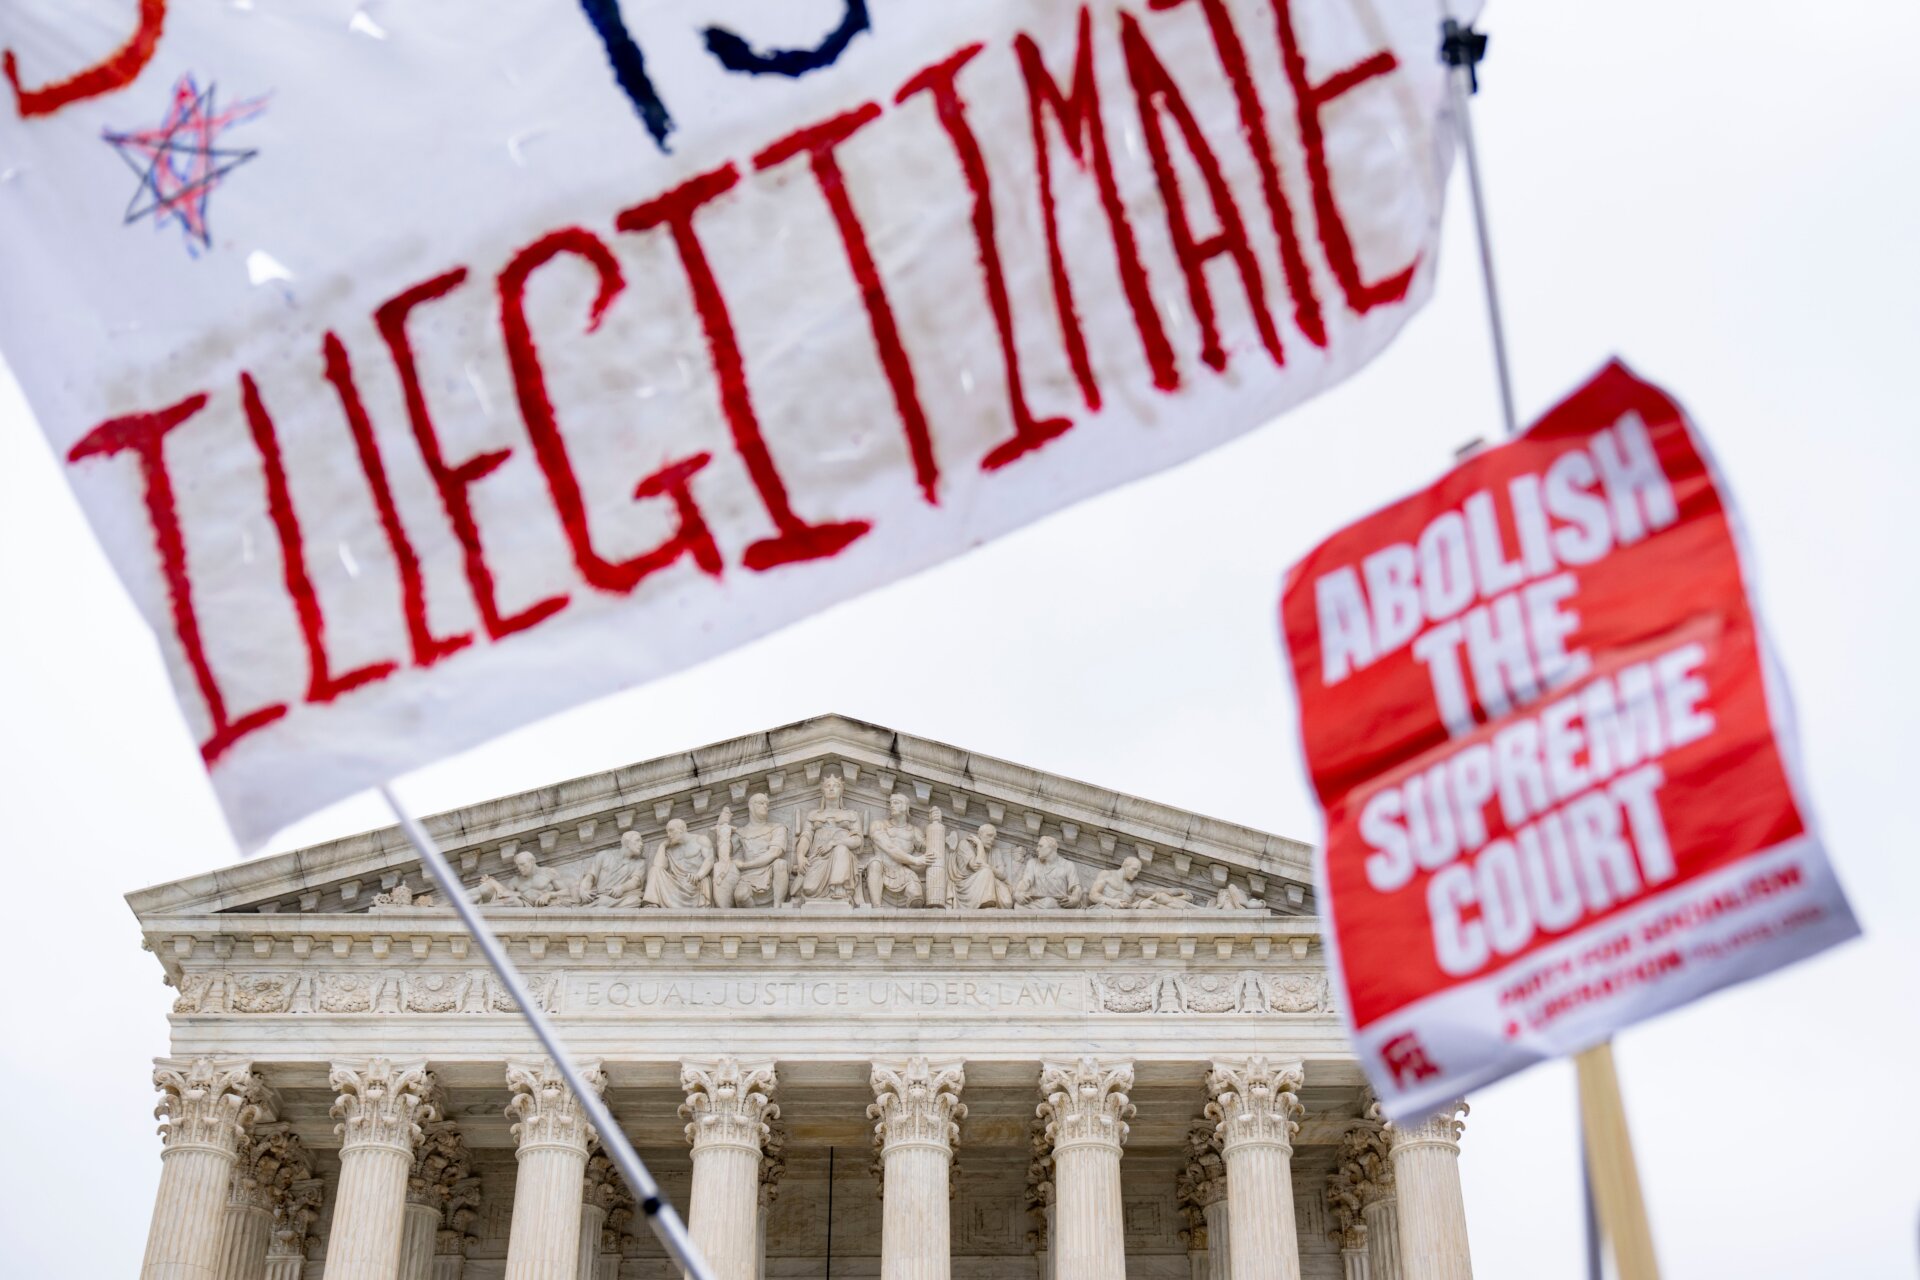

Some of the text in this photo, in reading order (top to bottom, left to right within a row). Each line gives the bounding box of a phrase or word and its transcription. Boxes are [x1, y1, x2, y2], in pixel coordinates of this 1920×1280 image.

[67, 0, 1425, 769] ILLEGITIMATE
[1315, 410, 1677, 686] ABOLISH
[1413, 573, 1592, 739] THE
[1359, 644, 1714, 891] SUPREME
[1428, 763, 1675, 976] COURT
[586, 982, 1063, 1007] EQUAL JUSTICE UNDER LAW
